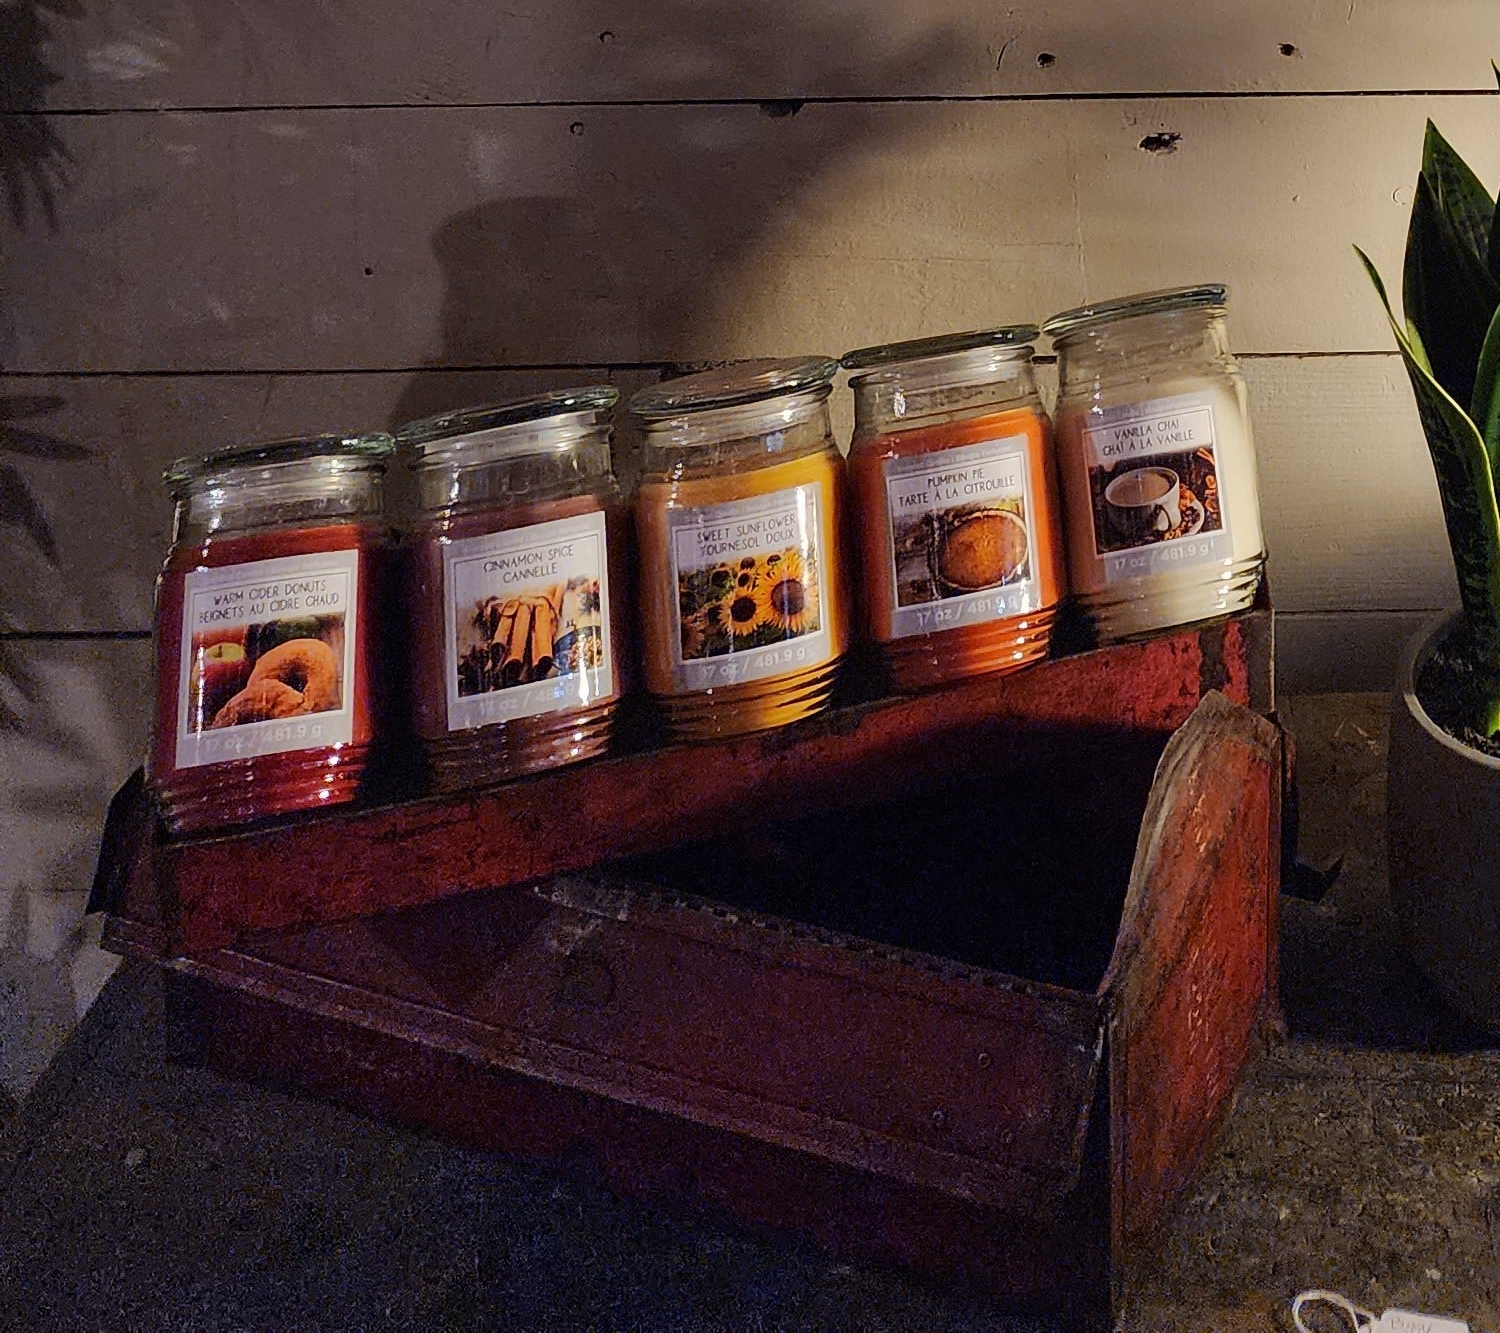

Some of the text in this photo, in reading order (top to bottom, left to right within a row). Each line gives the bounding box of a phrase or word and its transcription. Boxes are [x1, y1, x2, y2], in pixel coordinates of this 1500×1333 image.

[1113, 419, 1180, 441] VANILLA CHAI
[1139, 436, 1154, 450] LA
[1156, 429, 1194, 446] VANILLE
[898, 492, 929, 508] TARTE
[945, 487, 960, 500] LA
[963, 475, 1015, 495] CITROUILLE
[927, 468, 985, 489] PUMPKIN PIE
[696, 514, 797, 545] SWEET SUNFLOWER
[700, 527, 795, 557] TOURNESOL DOUX
[483, 544, 575, 573] CINNAMON SPICE
[502, 563, 560, 584] CANNELLE
[213, 579, 327, 607] WARM CIDER DONUTS
[199, 592, 340, 625] BEIGNETS AU CIDRE CHAUD
